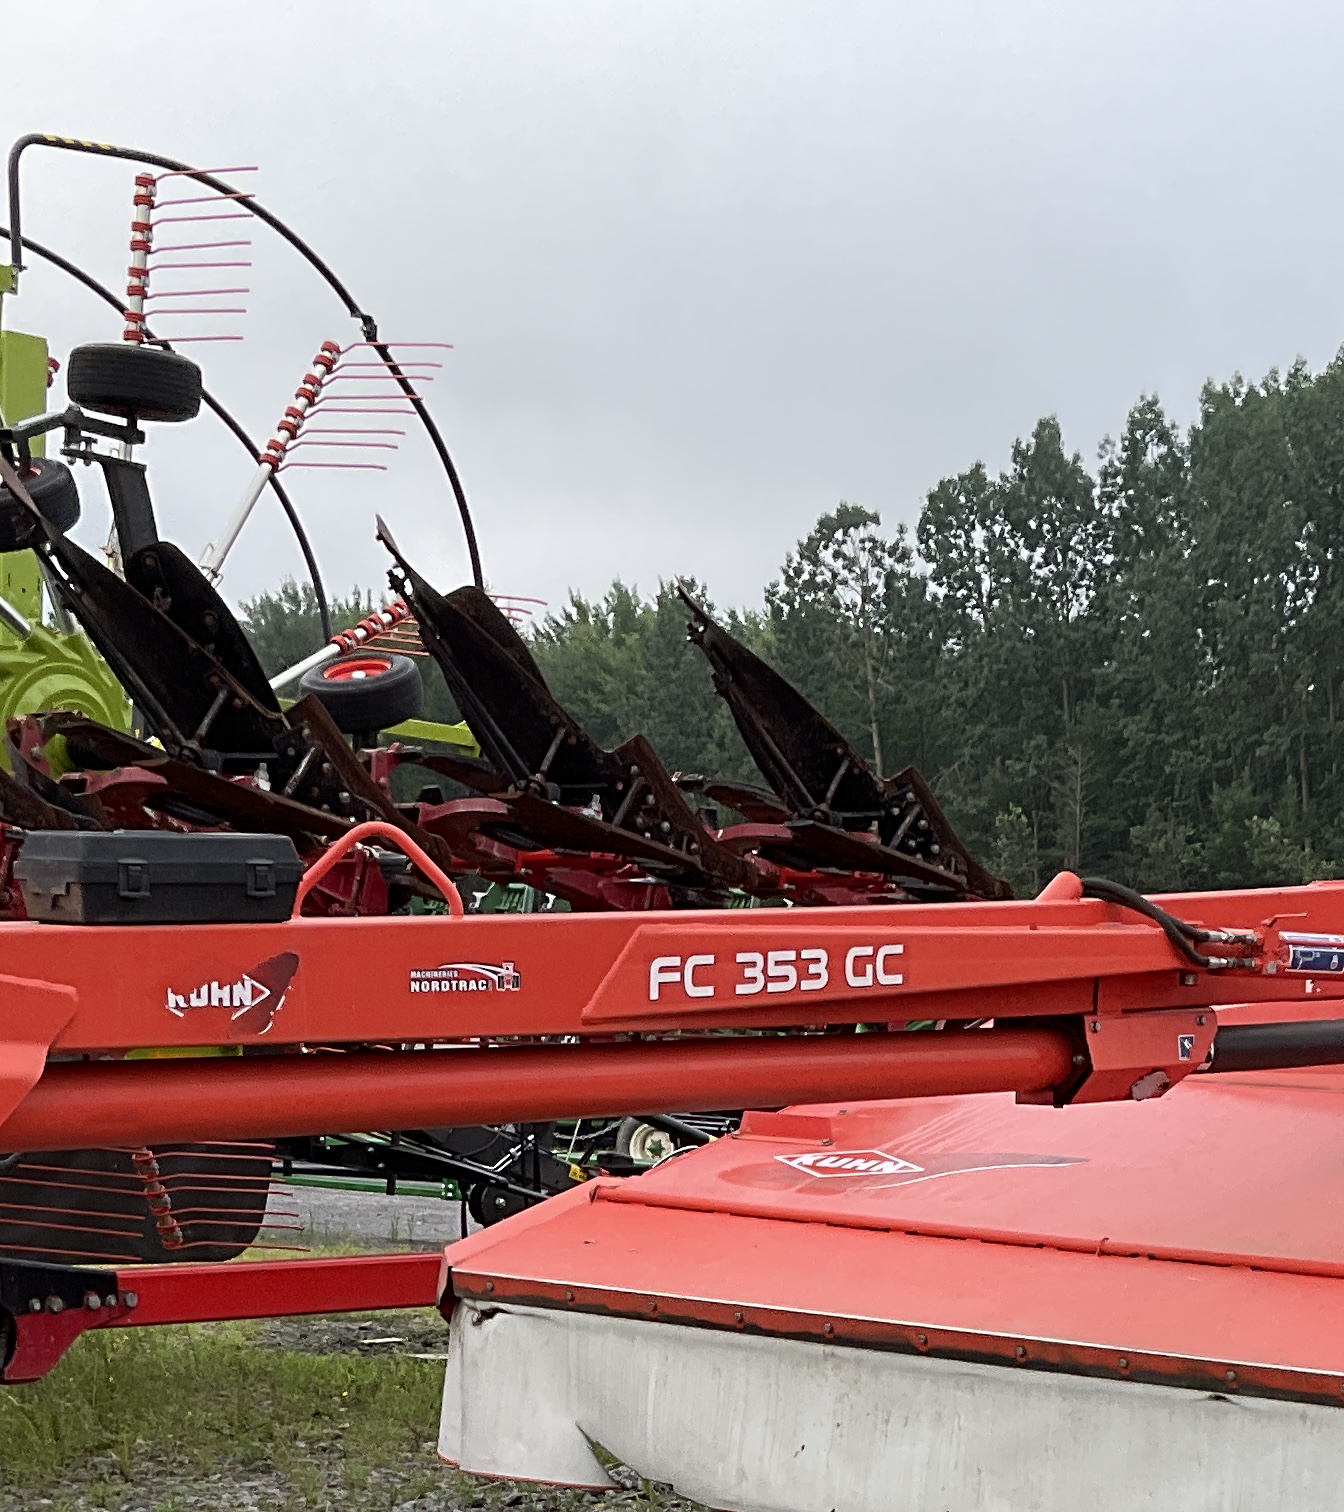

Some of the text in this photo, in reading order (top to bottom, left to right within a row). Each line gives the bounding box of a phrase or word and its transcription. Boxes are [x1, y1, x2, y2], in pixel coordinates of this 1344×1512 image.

[649, 944, 904, 1001] FC 353 GC
[410, 979, 488, 993] NORDTRAC
[789, 1153, 904, 1174] KUHN
